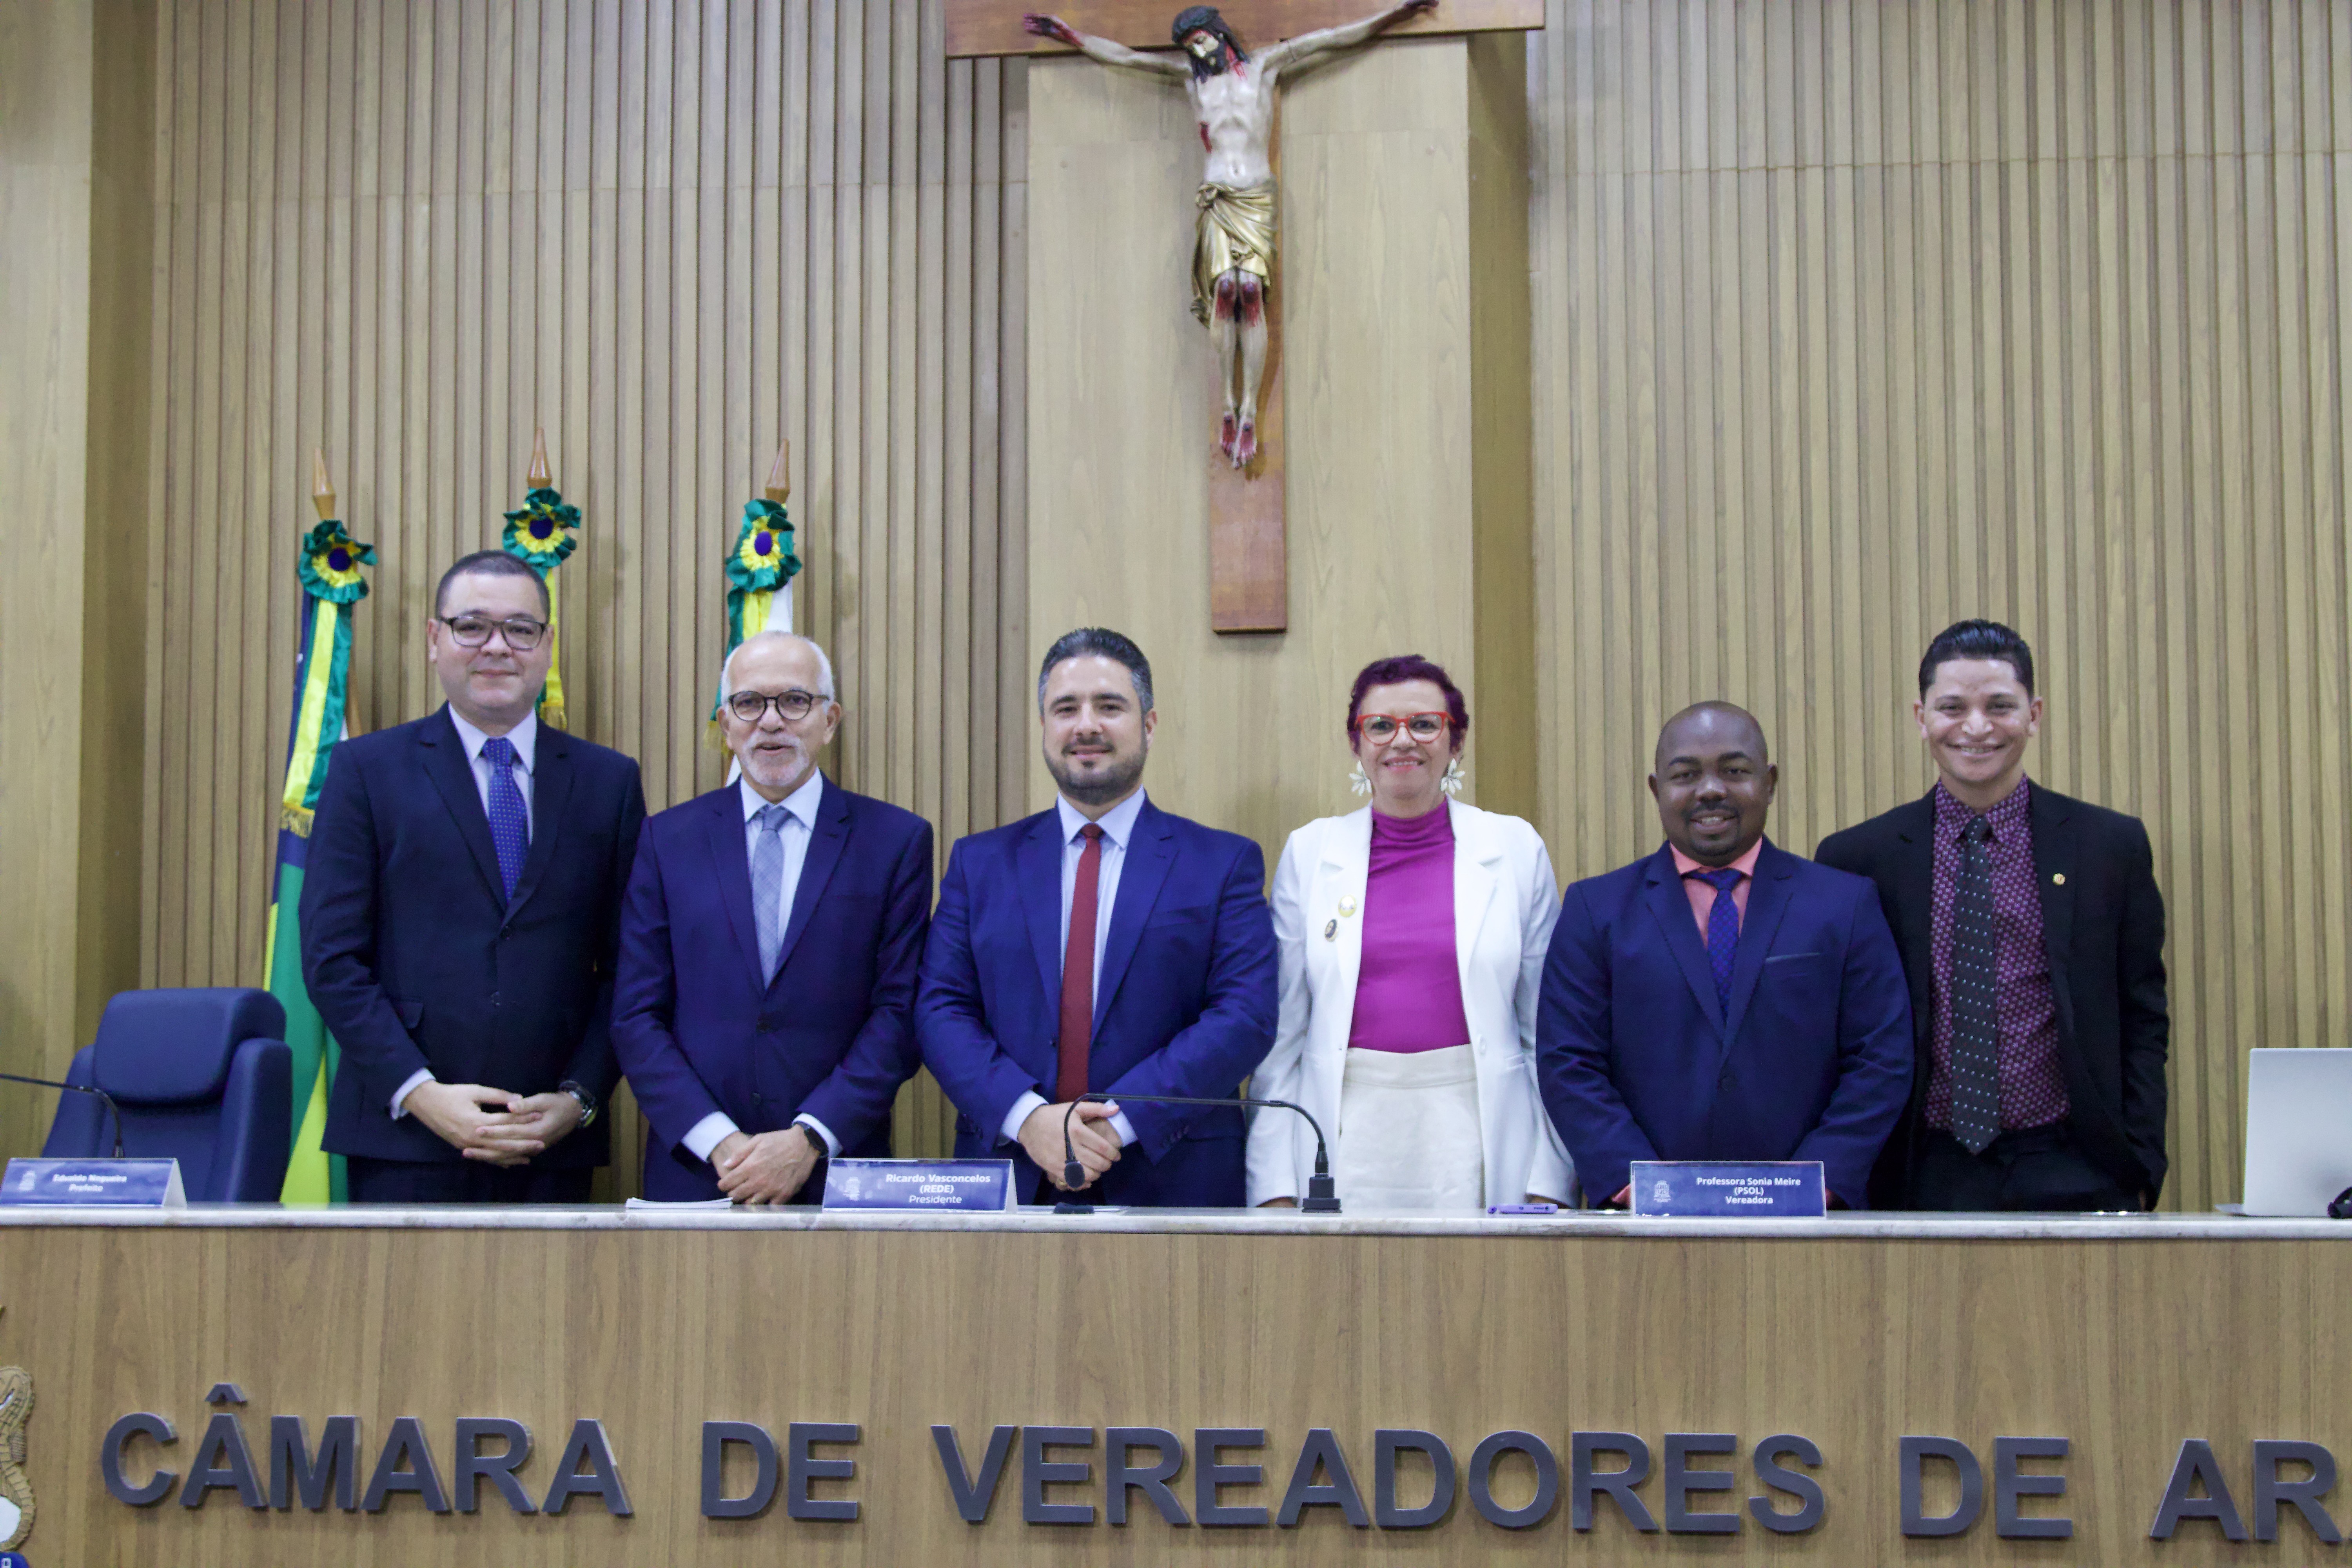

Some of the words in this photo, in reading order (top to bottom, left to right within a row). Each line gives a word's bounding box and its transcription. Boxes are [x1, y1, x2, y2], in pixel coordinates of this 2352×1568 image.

[886, 1174, 926, 1183] Ricardo
[928, 1174, 991, 1183] Vasconcelos
[1696, 1177, 1745, 1185] Professora
[1775, 1178, 1801, 1186] Meire
[919, 1185, 955, 1194] (REDE)
[1734, 1187, 1764, 1196] (PSOL)
[909, 1195, 962, 1204] Presidente
[1725, 1196, 1773, 1204] Vereadora
[101, 1383, 633, 1515] CÂMARA
[701, 1421, 859, 1519] DE
[930, 1425, 1826, 1532] VEREADORES
[1900, 1436, 2074, 1537] DE
[2149, 1438, 2352, 1543] AR
